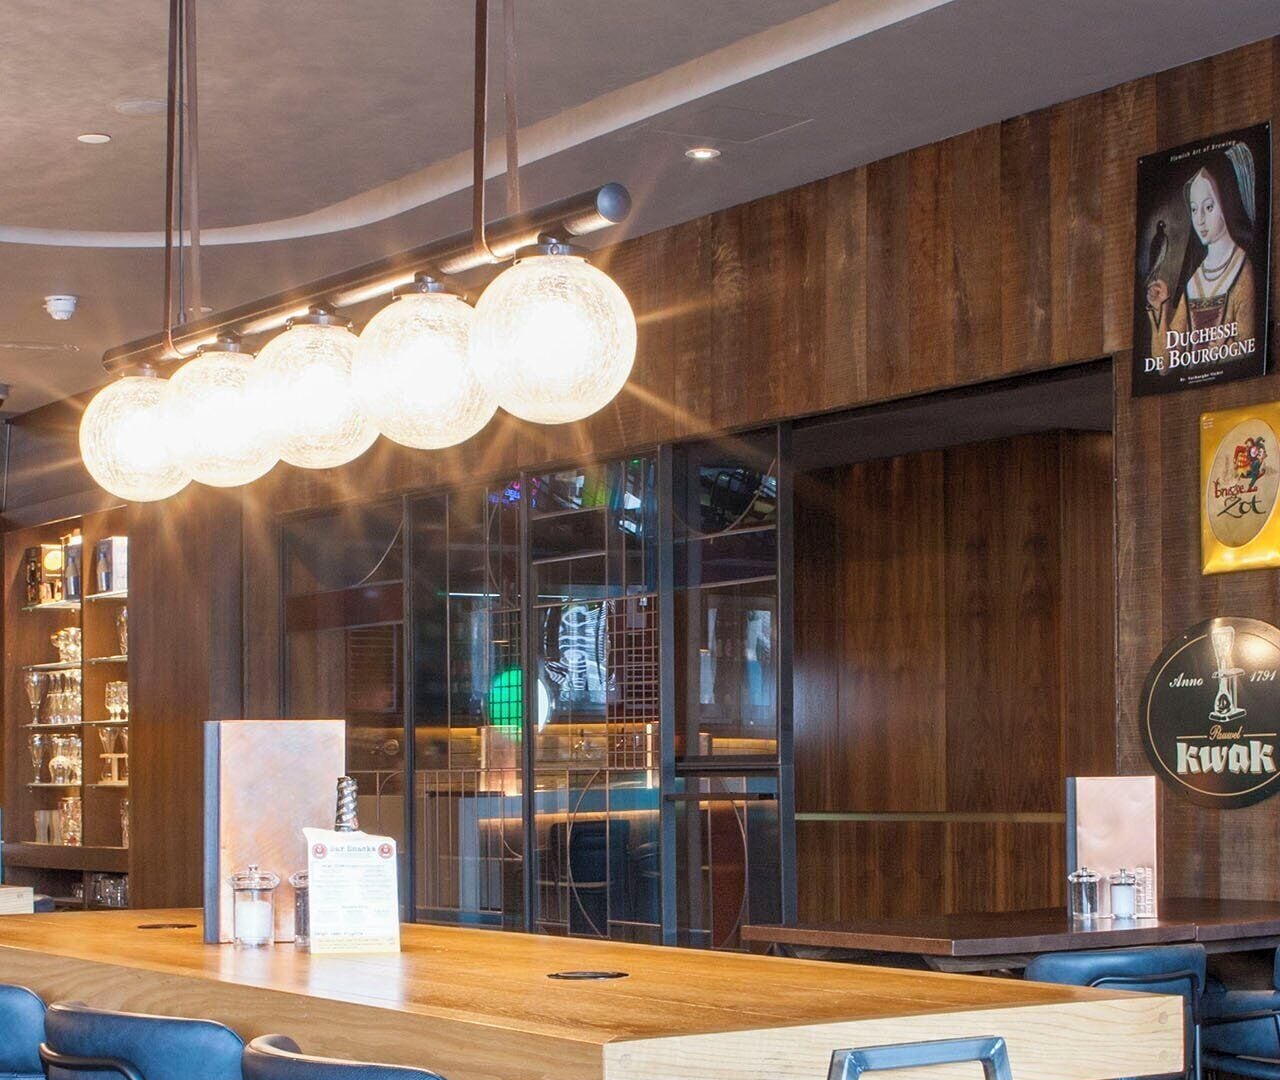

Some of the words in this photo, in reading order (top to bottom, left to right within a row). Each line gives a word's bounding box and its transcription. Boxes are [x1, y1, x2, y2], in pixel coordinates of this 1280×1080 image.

[1166, 321, 1238, 350] DUCHESSE
[1144, 354, 1164, 373] DE
[1169, 337, 1256, 370] BOURGOGNE
[1217, 495, 1267, 519] Zot
[1169, 673, 1204, 688] Anno
